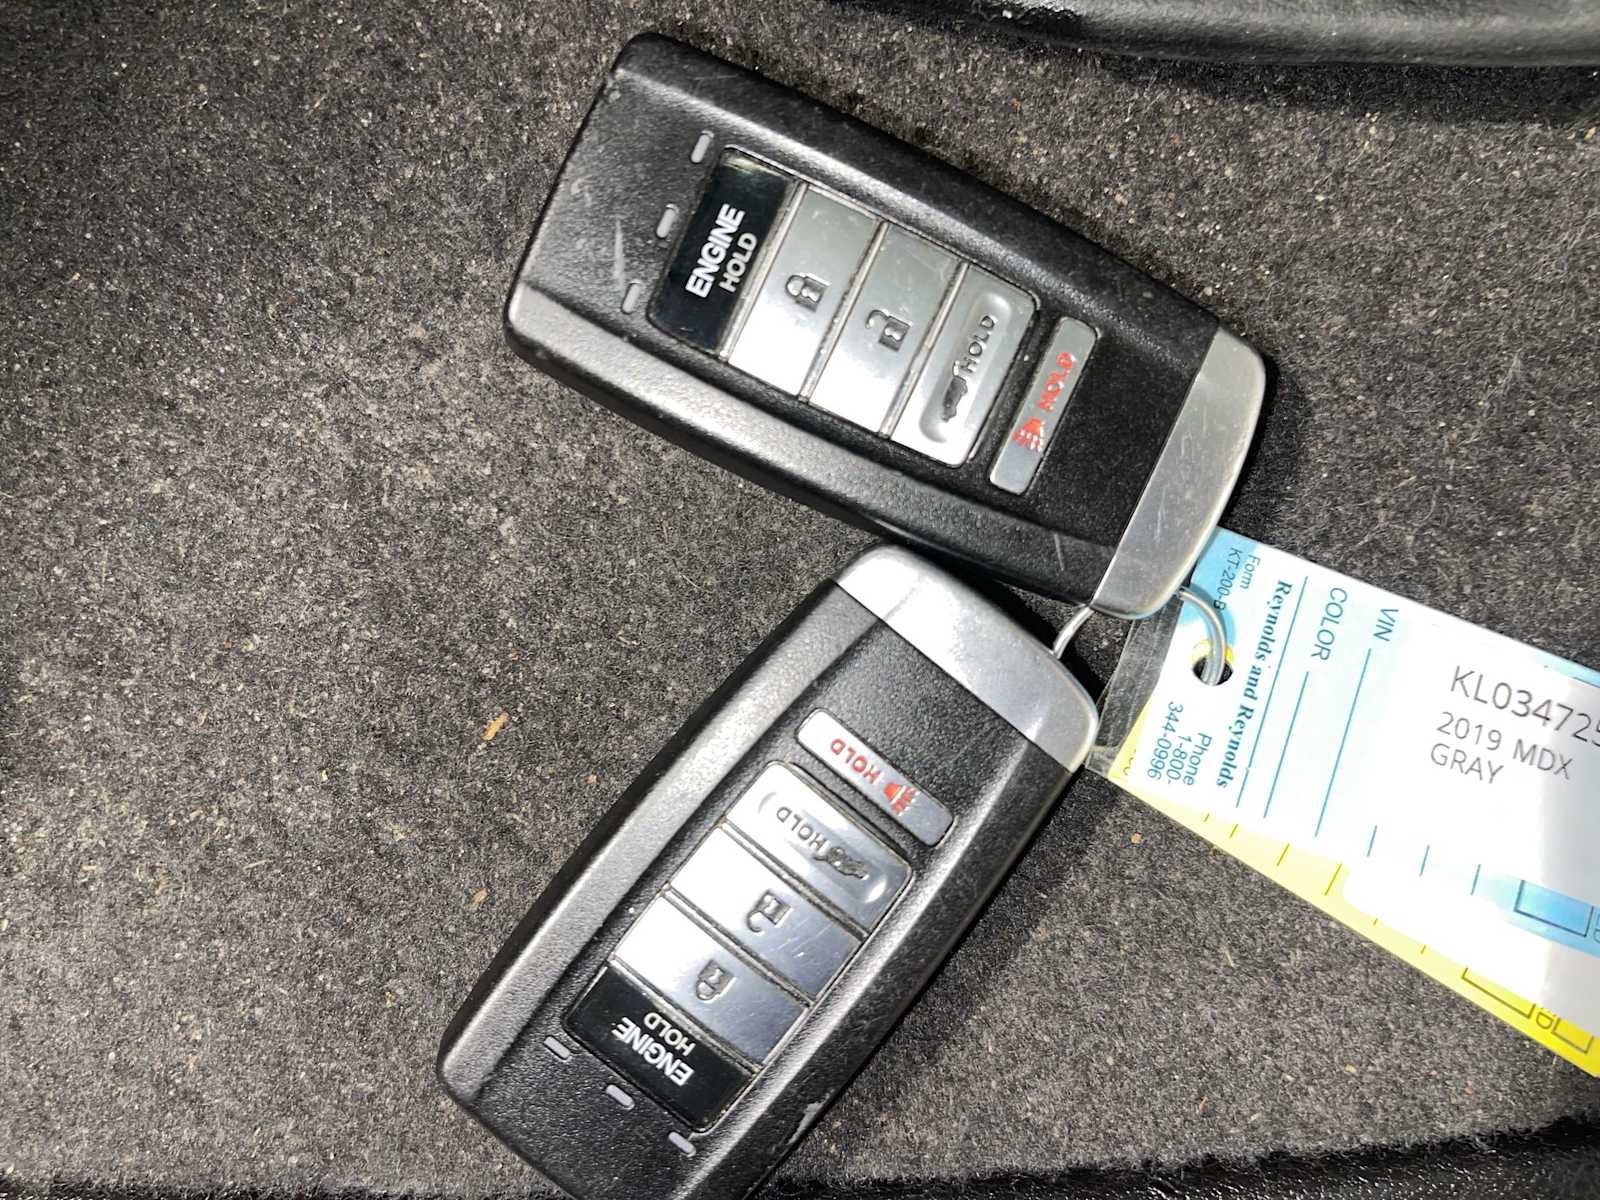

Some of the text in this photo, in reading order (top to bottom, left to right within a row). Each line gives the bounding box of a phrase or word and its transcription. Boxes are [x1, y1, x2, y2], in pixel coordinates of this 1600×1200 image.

[685, 204, 744, 299] ENGINE
[719, 230, 758, 293] HOLD
[963, 314, 997, 374] HOLD
[1038, 351, 1076, 413] HOLD
[1239, 554, 1261, 589] Form
[1309, 586, 1349, 662] COLOR
[1372, 607, 1399, 643] VIN
[1216, 580, 1293, 788] Reynolds and Reynolds
[830, 738, 882, 785] HOLD
[1147, 701, 1184, 780] 344-0996
[1183, 732, 1212, 786] Phone
[1430, 742, 1504, 784] GRAY
[1436, 711, 1573, 781] 2019 MDX
[775, 806, 832, 858] HOLD
[612, 1016, 695, 1087] ENGINE
[643, 1010, 696, 1057] HOLD
